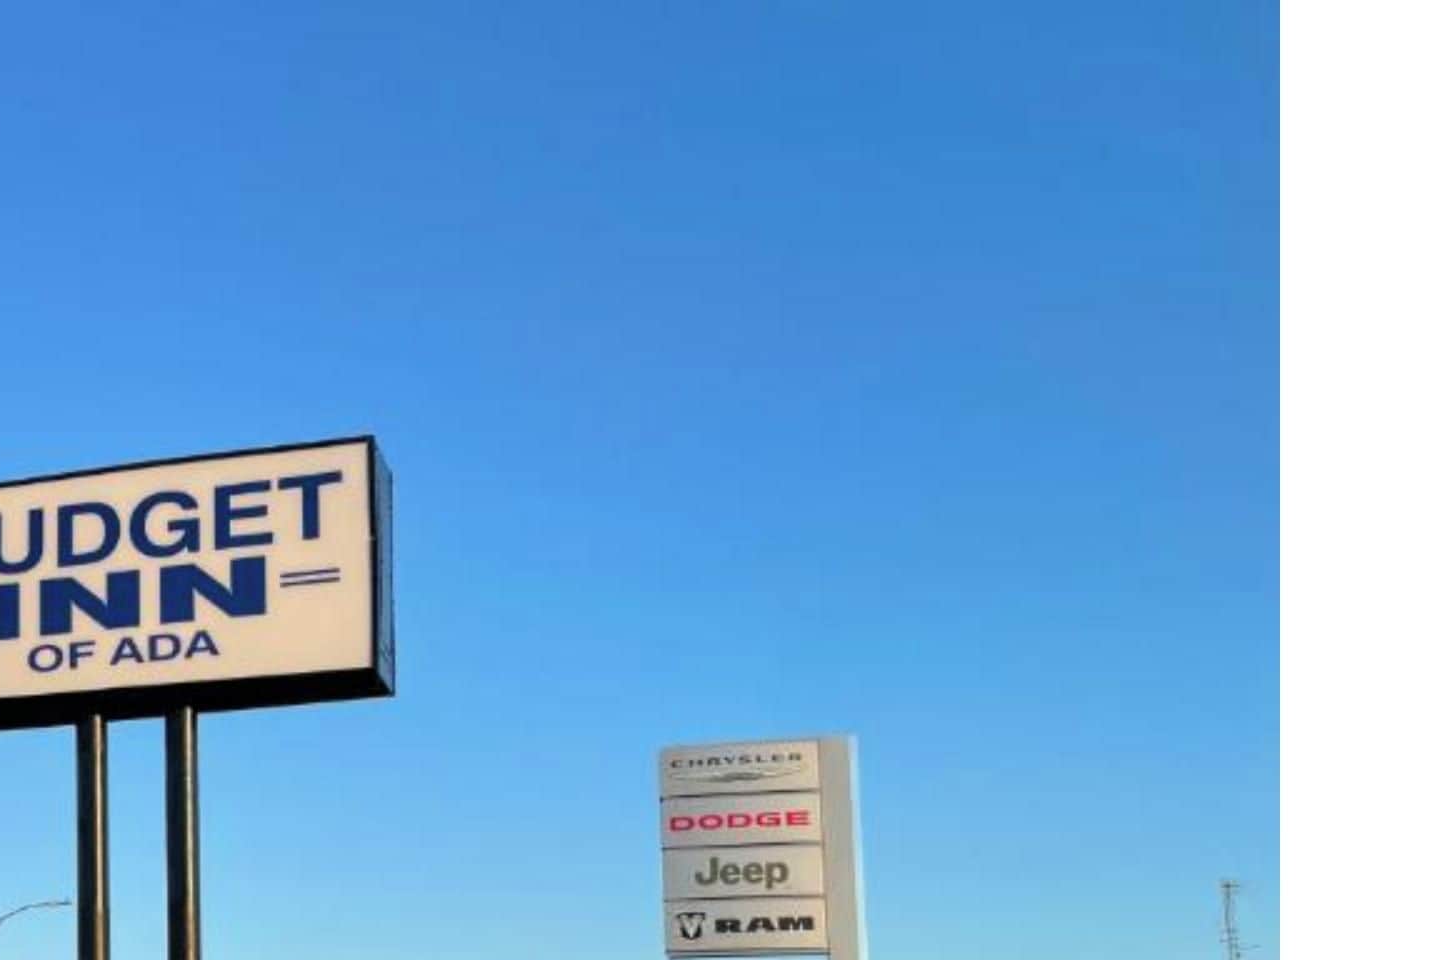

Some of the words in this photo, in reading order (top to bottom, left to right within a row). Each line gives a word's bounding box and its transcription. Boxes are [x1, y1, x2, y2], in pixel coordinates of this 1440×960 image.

[27, 640, 97, 673] OF
[109, 630, 220, 666] ADA
[670, 752, 802, 769] CHRYSLER
[669, 810, 812, 832] DODGE
[695, 857, 789, 889] Jeep
[714, 916, 815, 934] RAM
